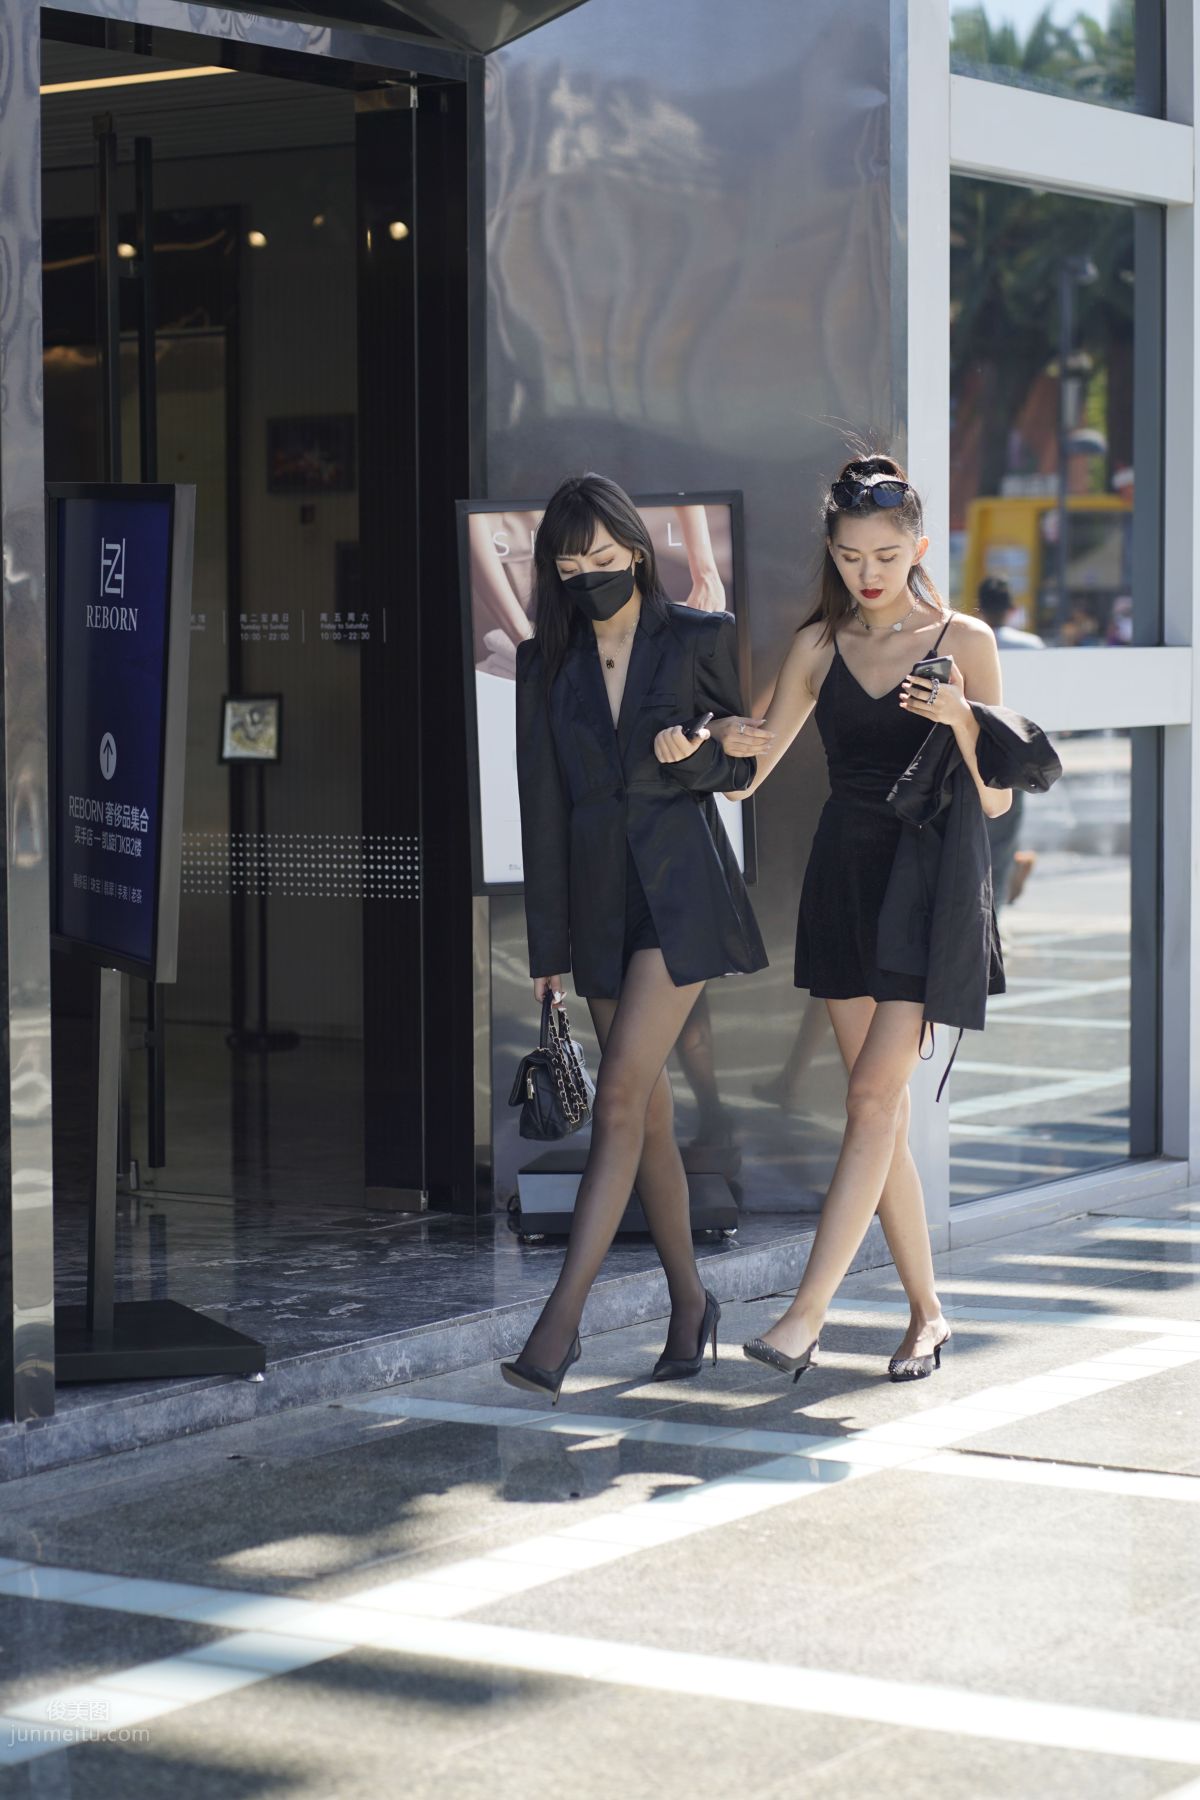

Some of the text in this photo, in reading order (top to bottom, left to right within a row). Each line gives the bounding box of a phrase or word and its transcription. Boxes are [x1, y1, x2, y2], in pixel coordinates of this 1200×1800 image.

[86, 605, 139, 631] REBORN
[69, 796, 149, 833] REBORN 奢侈品集合
